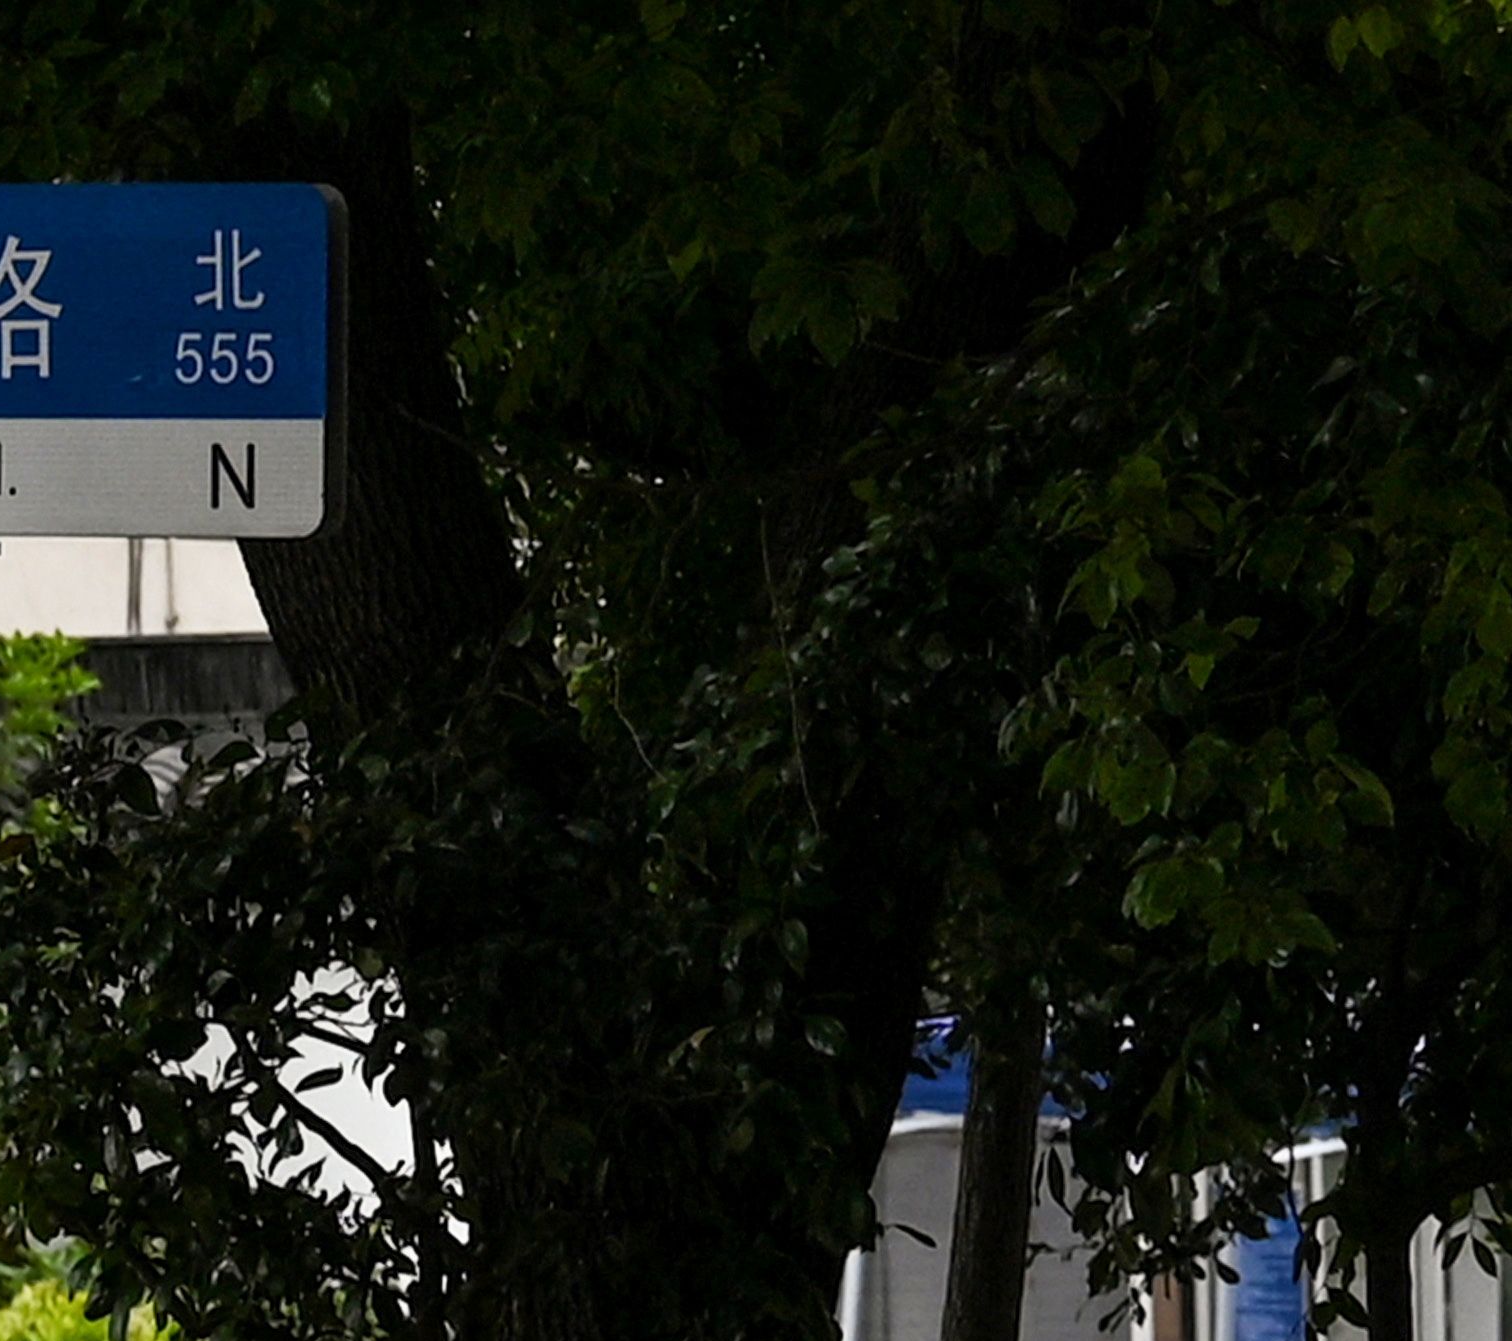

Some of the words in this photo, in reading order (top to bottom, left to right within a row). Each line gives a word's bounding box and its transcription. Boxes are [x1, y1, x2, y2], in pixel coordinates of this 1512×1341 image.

[193, 228, 266, 312] 北
[173, 332, 275, 386] 555
[208, 441, 257, 510] N
